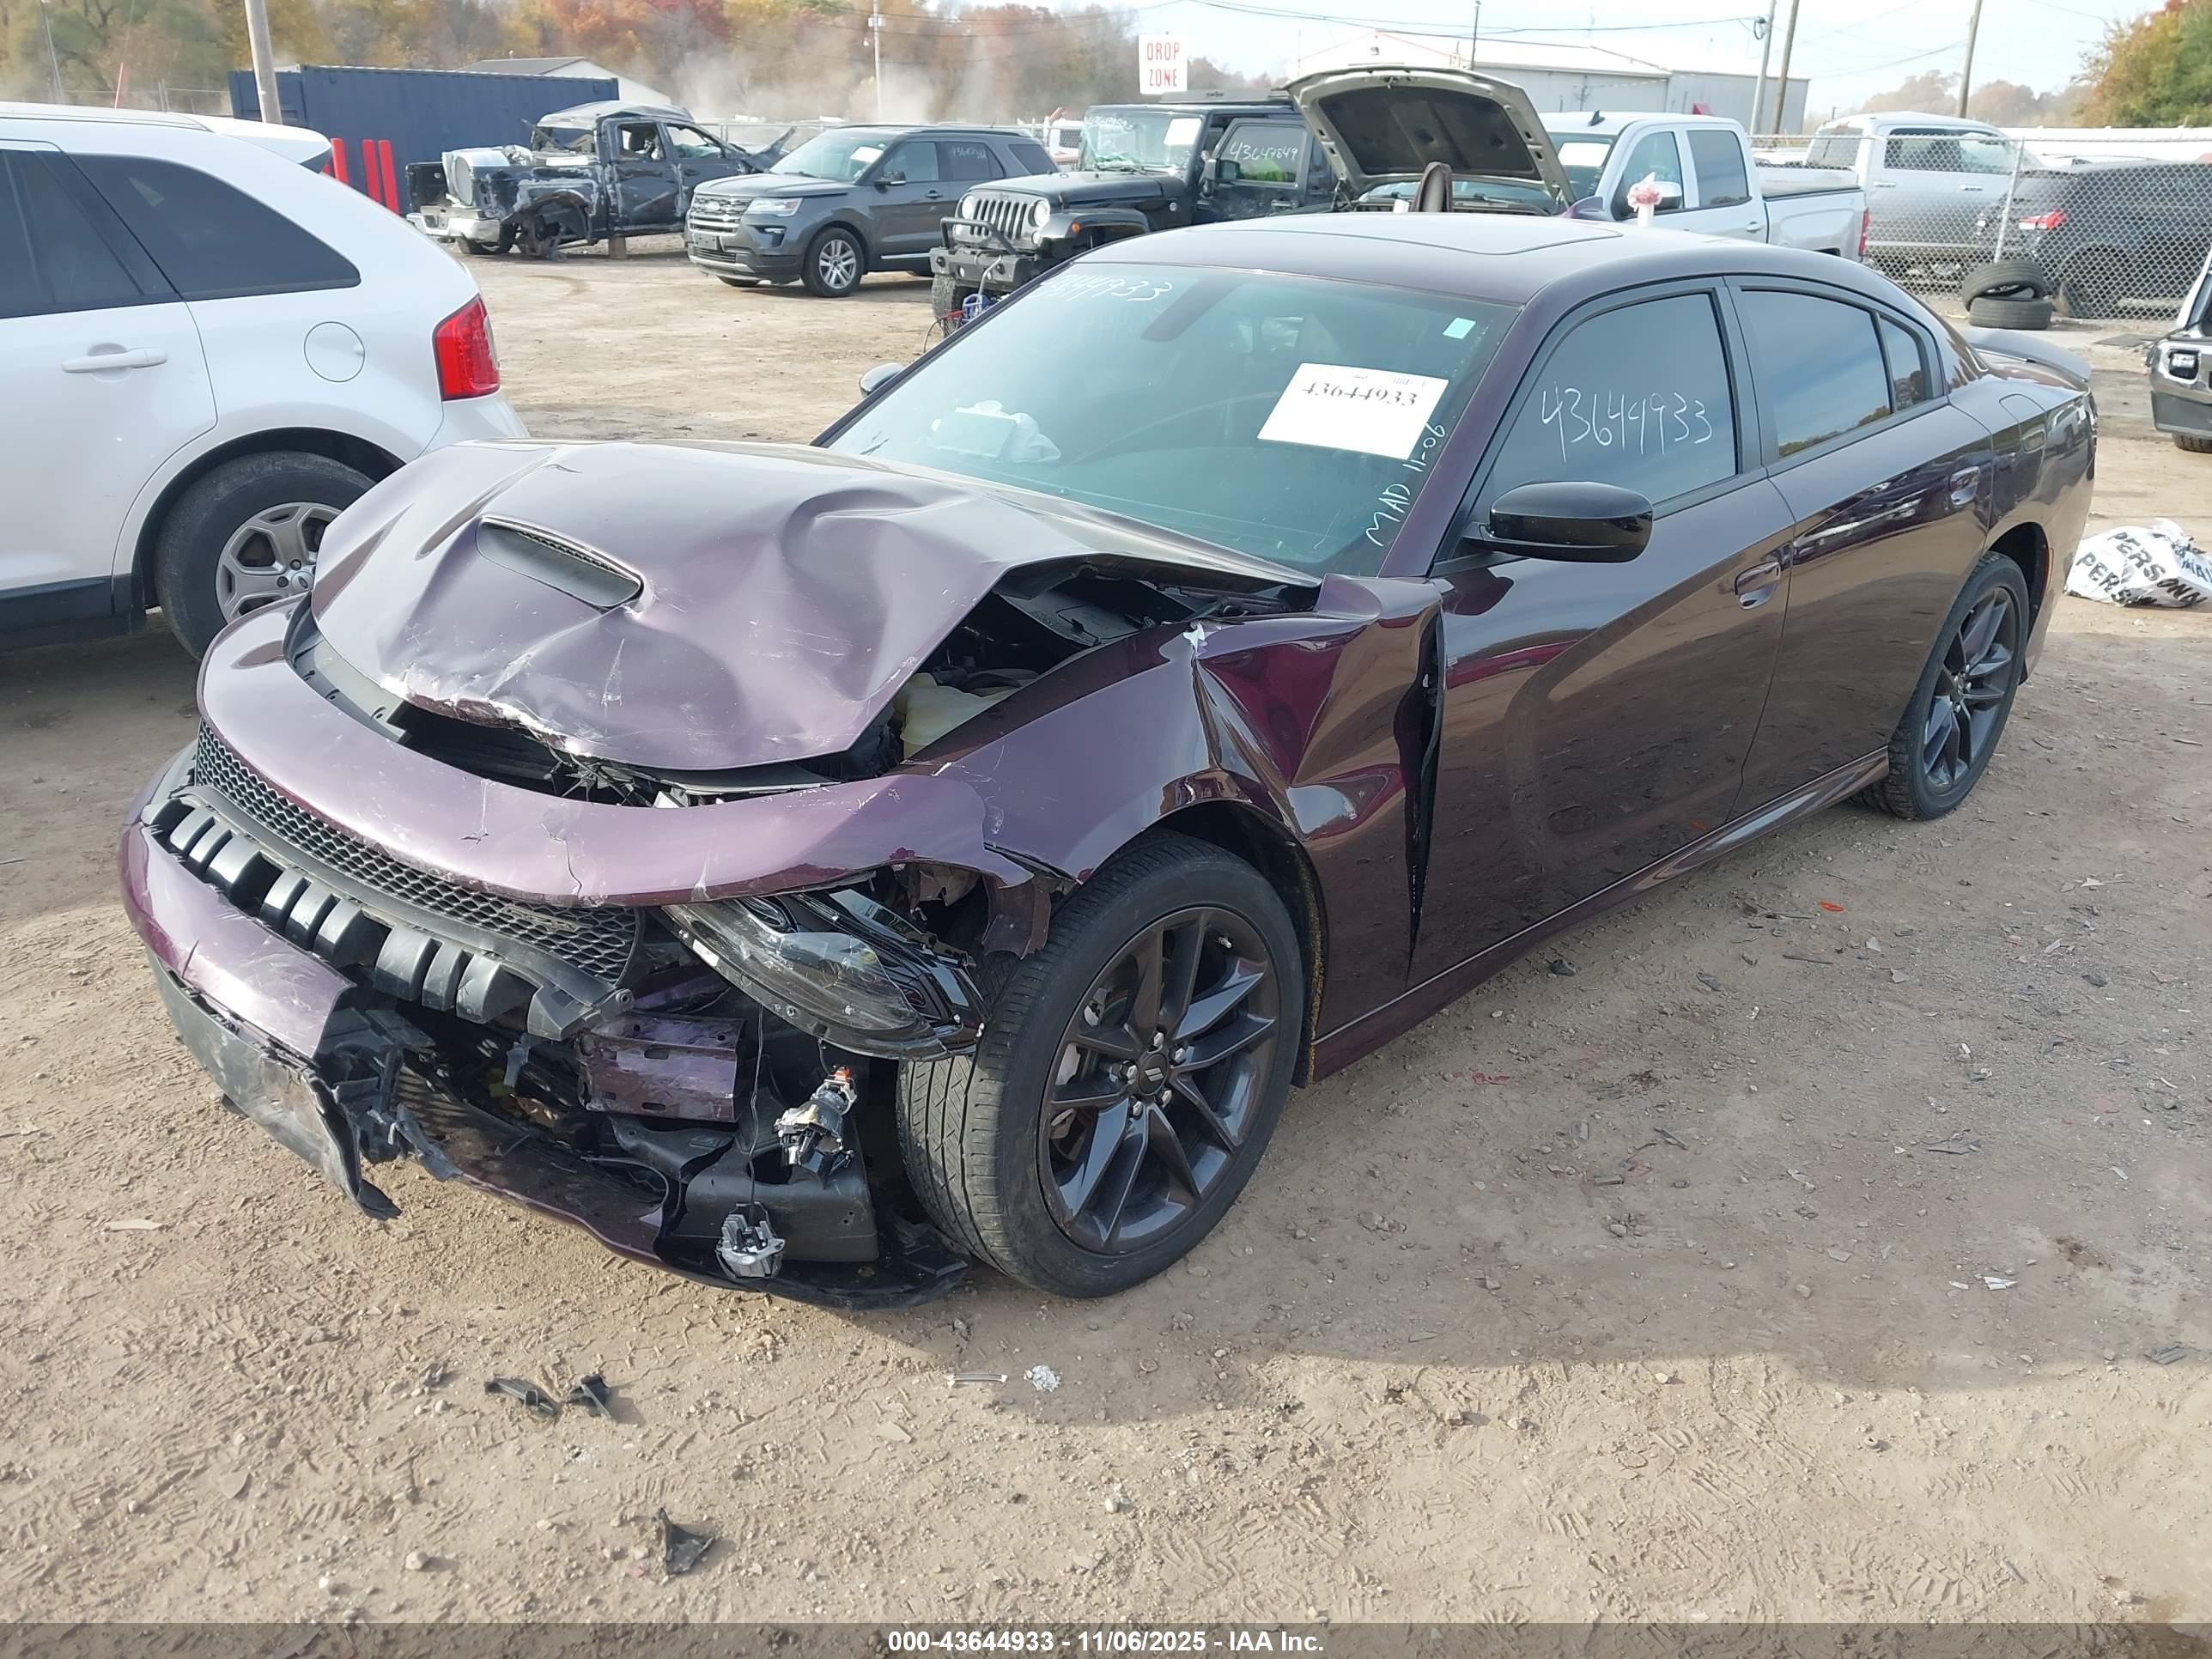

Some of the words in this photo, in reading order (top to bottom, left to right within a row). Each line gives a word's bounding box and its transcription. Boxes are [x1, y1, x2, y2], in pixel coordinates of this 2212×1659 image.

[1146, 42, 1181, 61] DROP
[1149, 68, 1177, 87] ZONE
[1541, 382, 1712, 463] 43644933
[1365, 483, 1411, 547] MAD
[1402, 423, 1446, 472] 11-06
